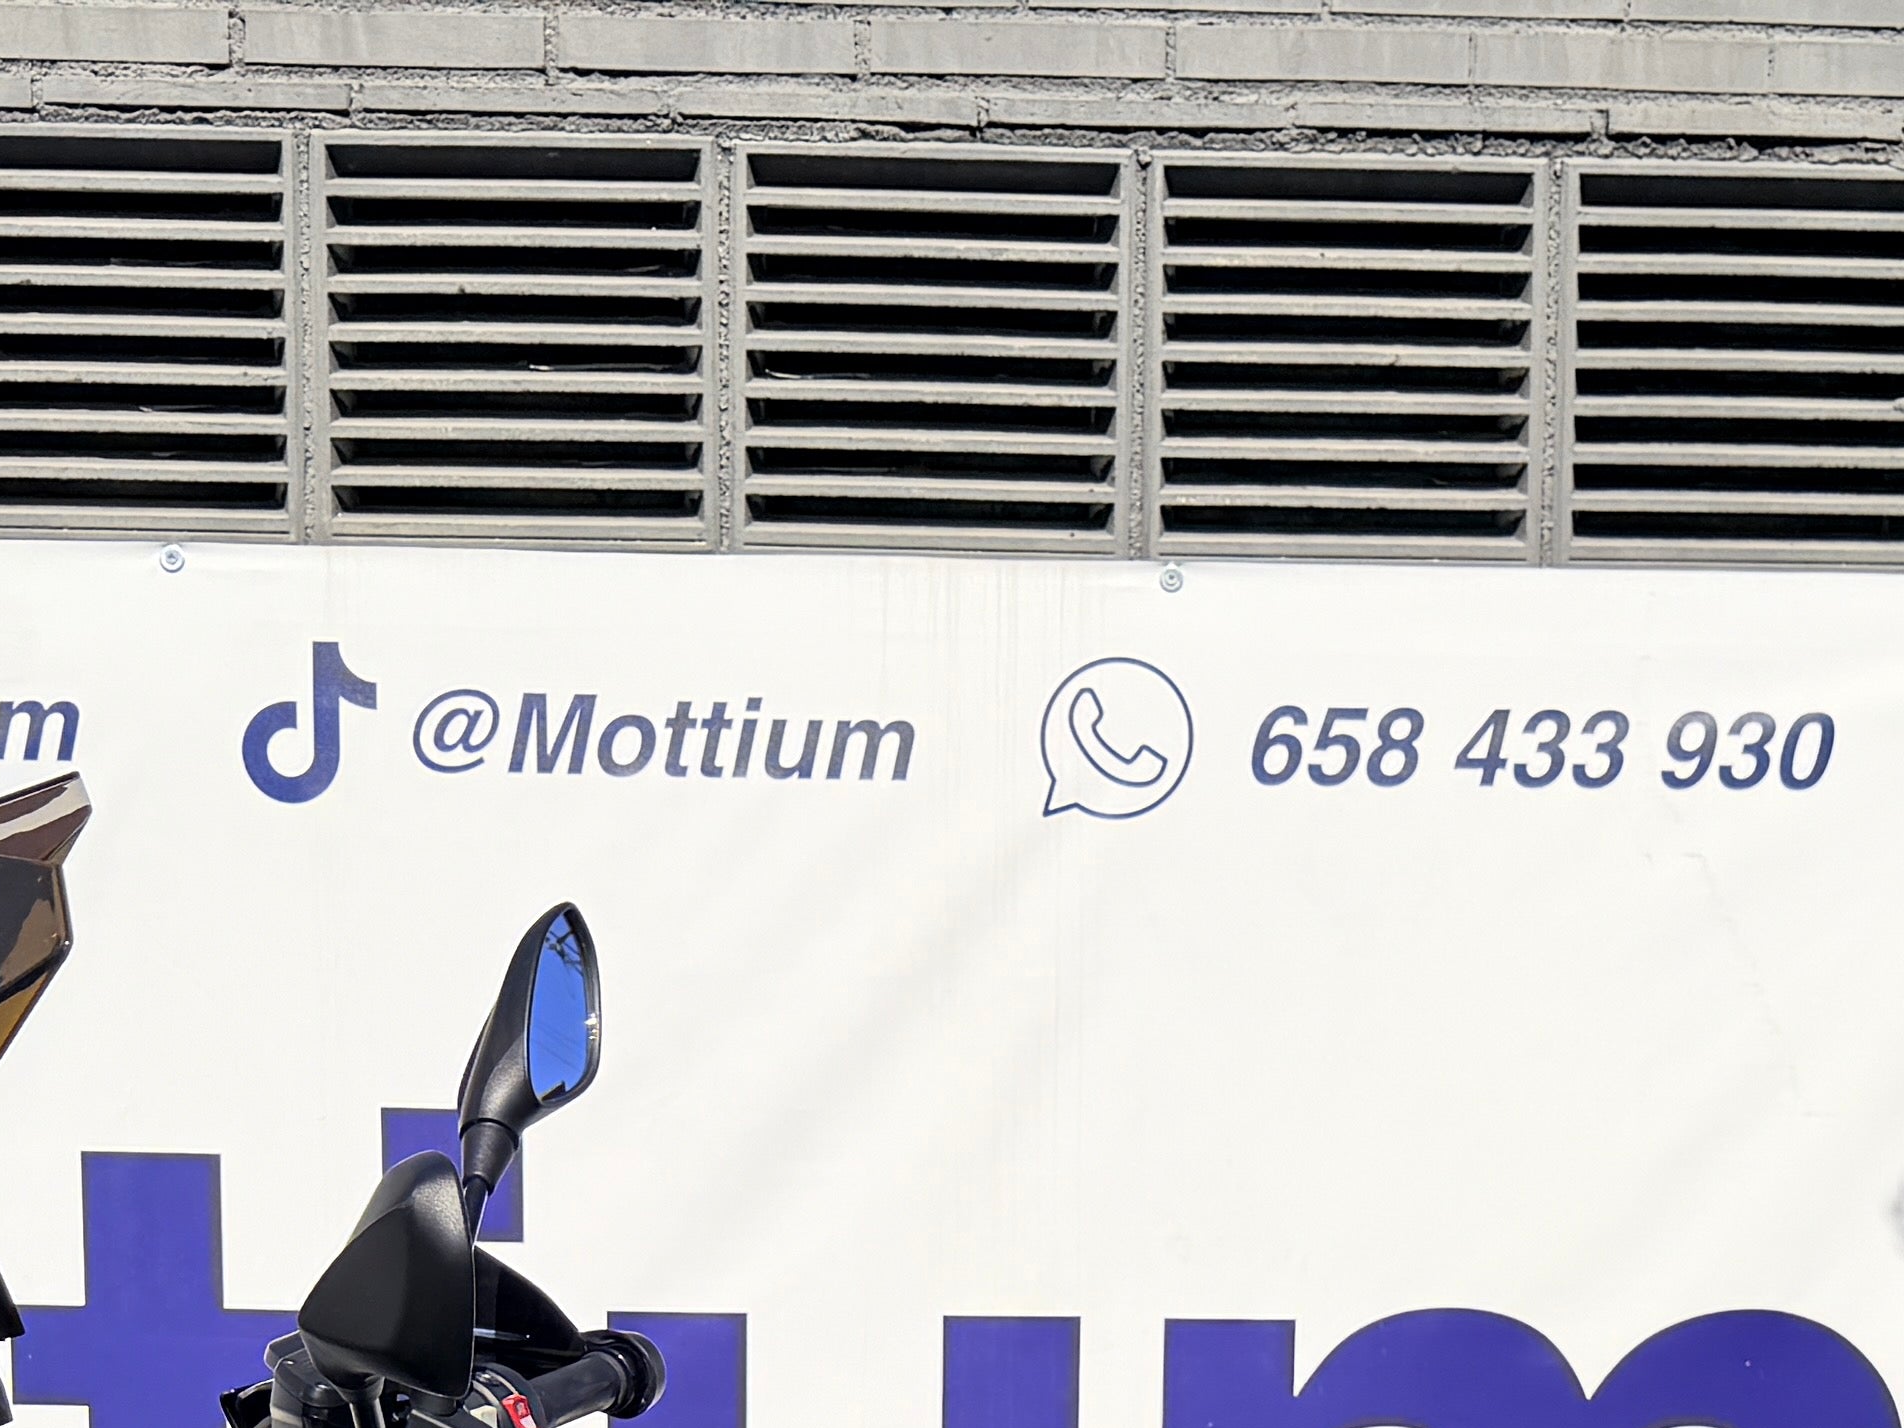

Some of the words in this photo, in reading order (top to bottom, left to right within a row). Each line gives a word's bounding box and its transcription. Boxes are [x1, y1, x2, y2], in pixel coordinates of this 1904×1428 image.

[413, 689, 915, 780] @Mottium
[1251, 705, 1425, 787] 658
[1454, 709, 1629, 788] 433
[1661, 711, 1836, 790] 930
